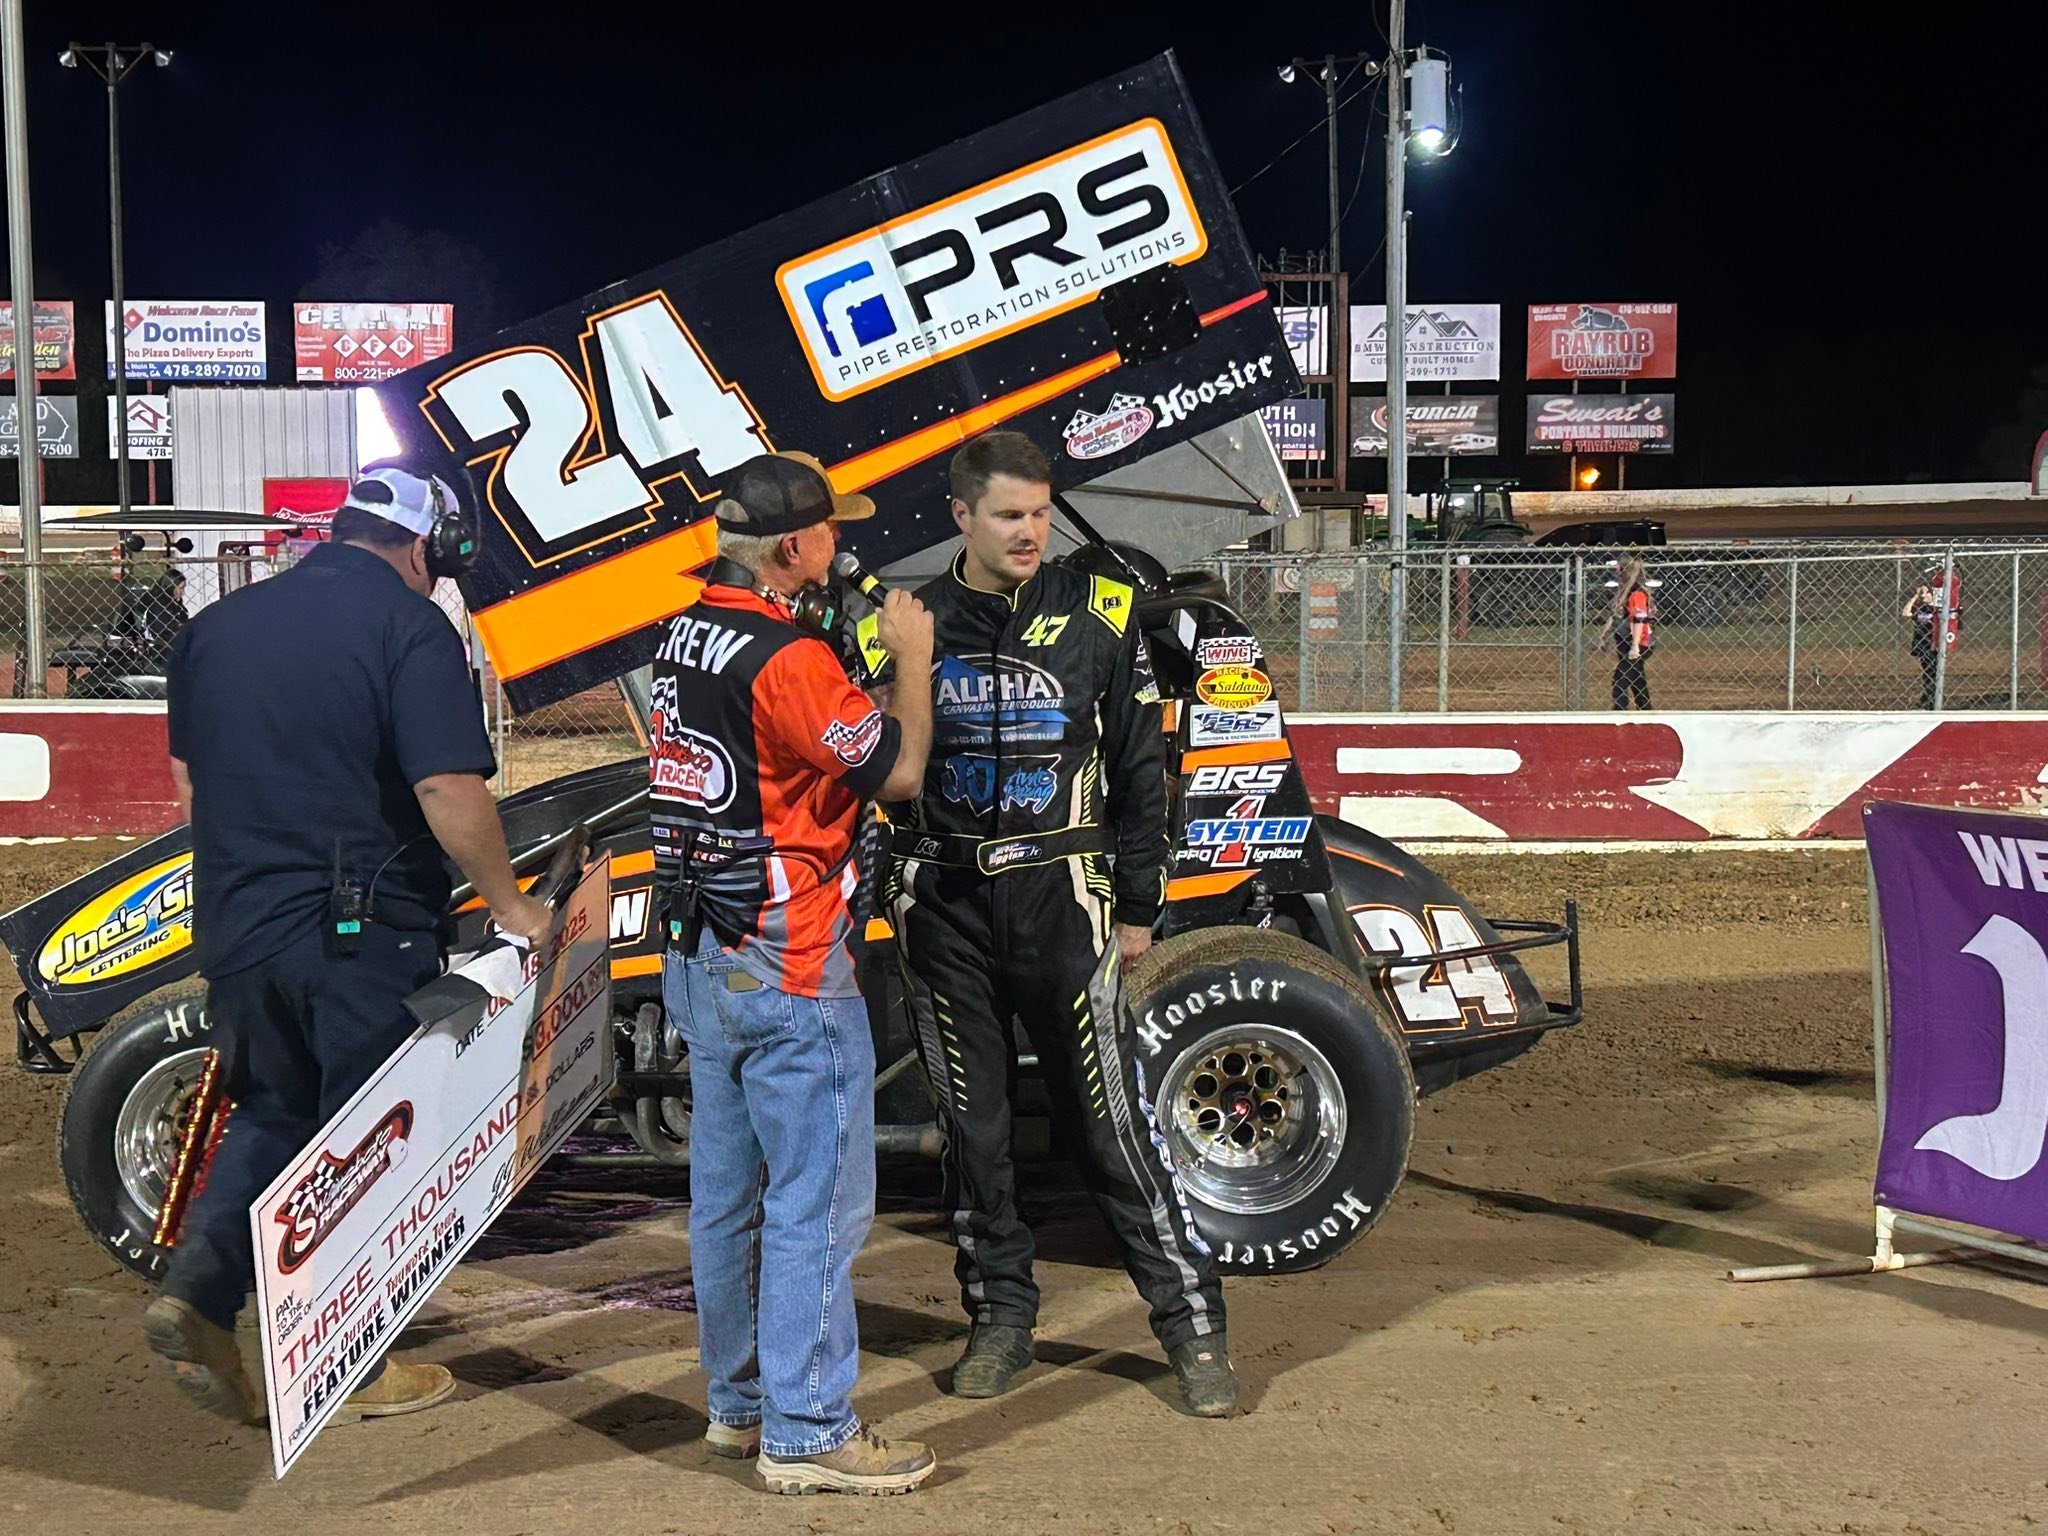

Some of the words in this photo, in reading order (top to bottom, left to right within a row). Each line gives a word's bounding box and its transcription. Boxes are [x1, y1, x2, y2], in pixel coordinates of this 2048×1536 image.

[889, 149, 1170, 325] PRS
[838, 350, 891, 381] PIPE
[896, 288, 1050, 357] RESTORATION
[1055, 232, 1186, 295] SOLUTIONS
[143, 321, 261, 343] Domino's
[1354, 342, 1384, 352] BMW
[1555, 332, 1650, 354] RAYROB
[142, 348, 170, 358] Pizza
[172, 347, 214, 359] Delivery
[217, 348, 253, 359] Experts
[163, 364, 261, 377] 478-289-7070
[1152, 355, 1273, 430] Hoosier
[437, 297, 768, 543] 24
[1404, 406, 1479, 420] EORGIA
[1537, 398, 1664, 422] Sweat's
[1540, 424, 1601, 439] PORTABLE
[1603, 424, 1664, 439] BUILDINGS
[1575, 440, 1640, 452] TRAILERS
[1020, 614, 1071, 647] 47
[1208, 647, 1249, 659] WING
[937, 673, 1052, 706] ALPHA
[1218, 681, 1269, 693] Saldana
[1189, 765, 1288, 791] BRS
[1188, 820, 1309, 843] SYSTEM
[1253, 846, 1303, 862] Ignition
[54, 904, 149, 976] Joe's
[91, 930, 171, 976] LETTERING
[1353, 908, 1516, 1022] 24
[1136, 971, 1287, 1056] Hoosier
[455, 1016, 485, 1060] DATE
[381, 1091, 522, 1260] THOUSAND
[1218, 1186, 1371, 1269] Hoosier
[275, 1289, 295, 1322] PAY
[282, 1255, 374, 1378] THREE
[303, 1308, 386, 1422] FEATURE
[390, 1215, 466, 1316] WINNER
